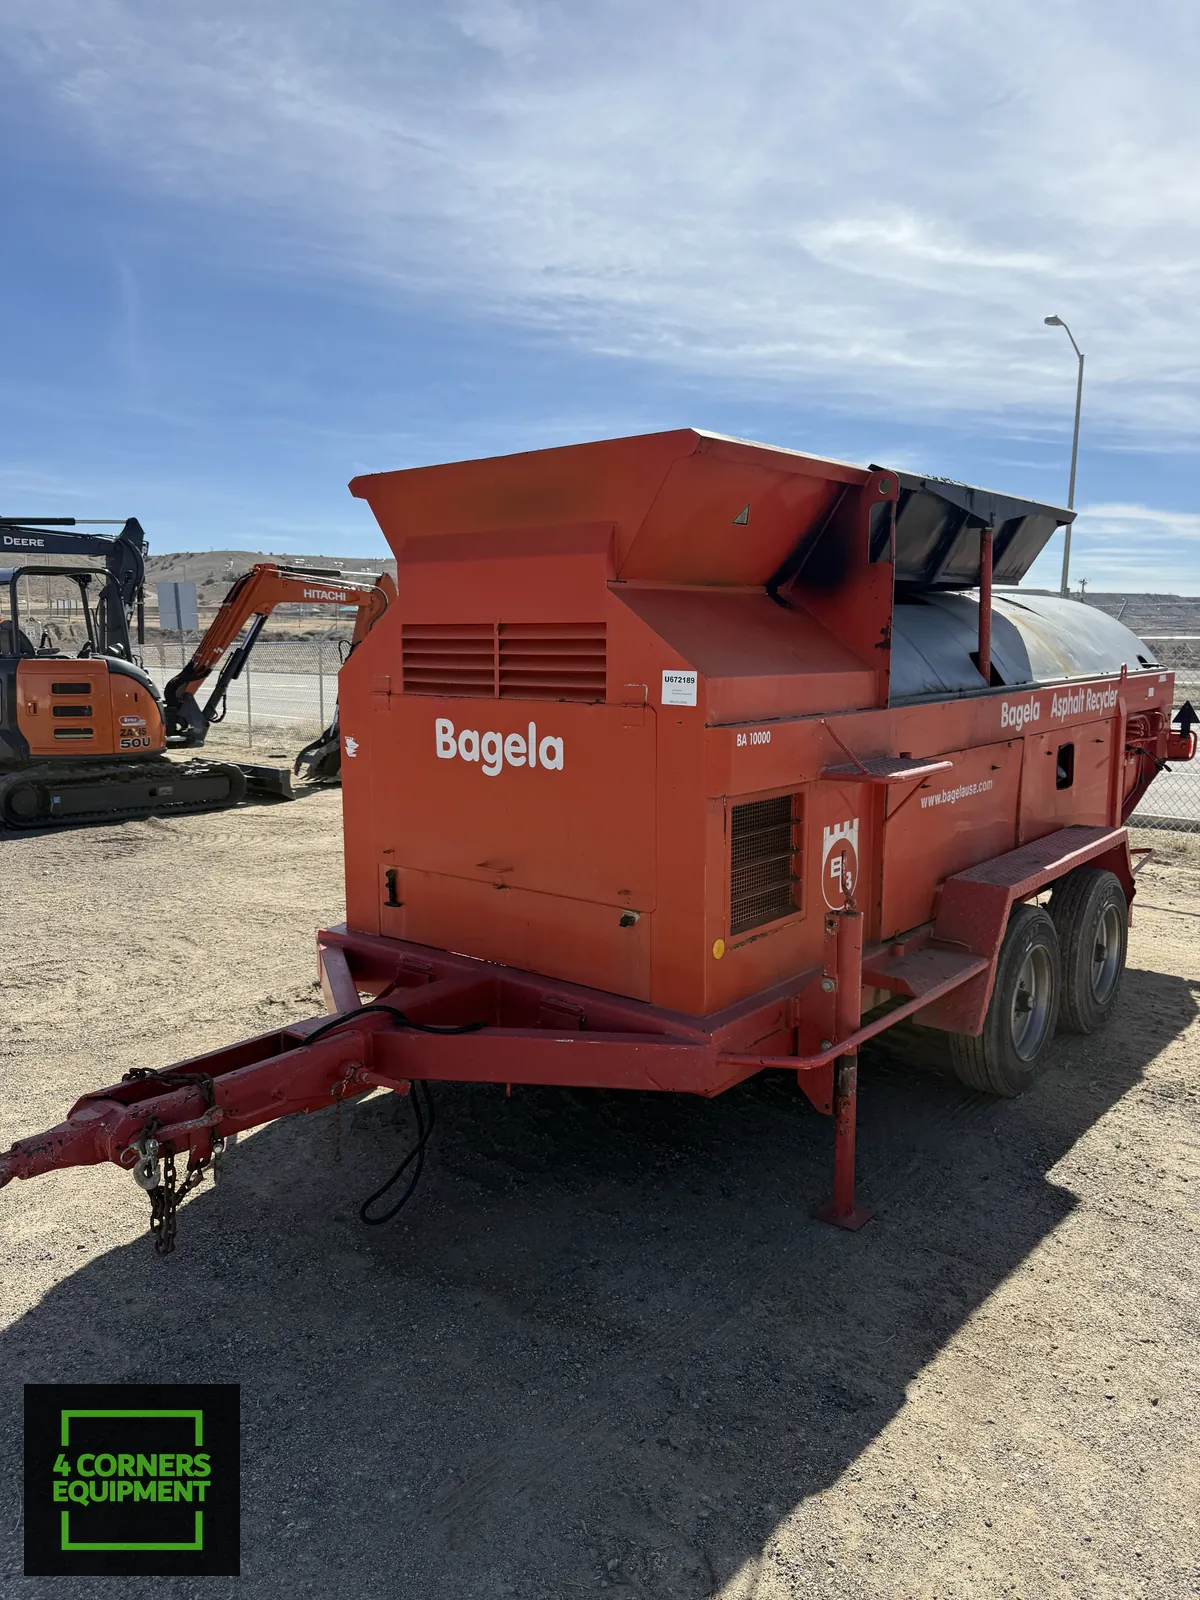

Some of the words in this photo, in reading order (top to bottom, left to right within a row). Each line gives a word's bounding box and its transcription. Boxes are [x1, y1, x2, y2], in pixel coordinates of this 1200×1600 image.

[4, 536, 45, 547] DEERE
[303, 589, 346, 601] HITACHI
[664, 676, 695, 684] U672189
[1001, 694, 1040, 732] Bagela
[1050, 688, 1085, 723] Asphalt
[1086, 684, 1118, 715] Recycler
[120, 736, 151, 749] 50U
[736, 733, 747, 746] BA
[749, 731, 771, 744] 10000
[435, 718, 564, 777] Bagela
[920, 780, 993, 808] www.bagelausa.com
